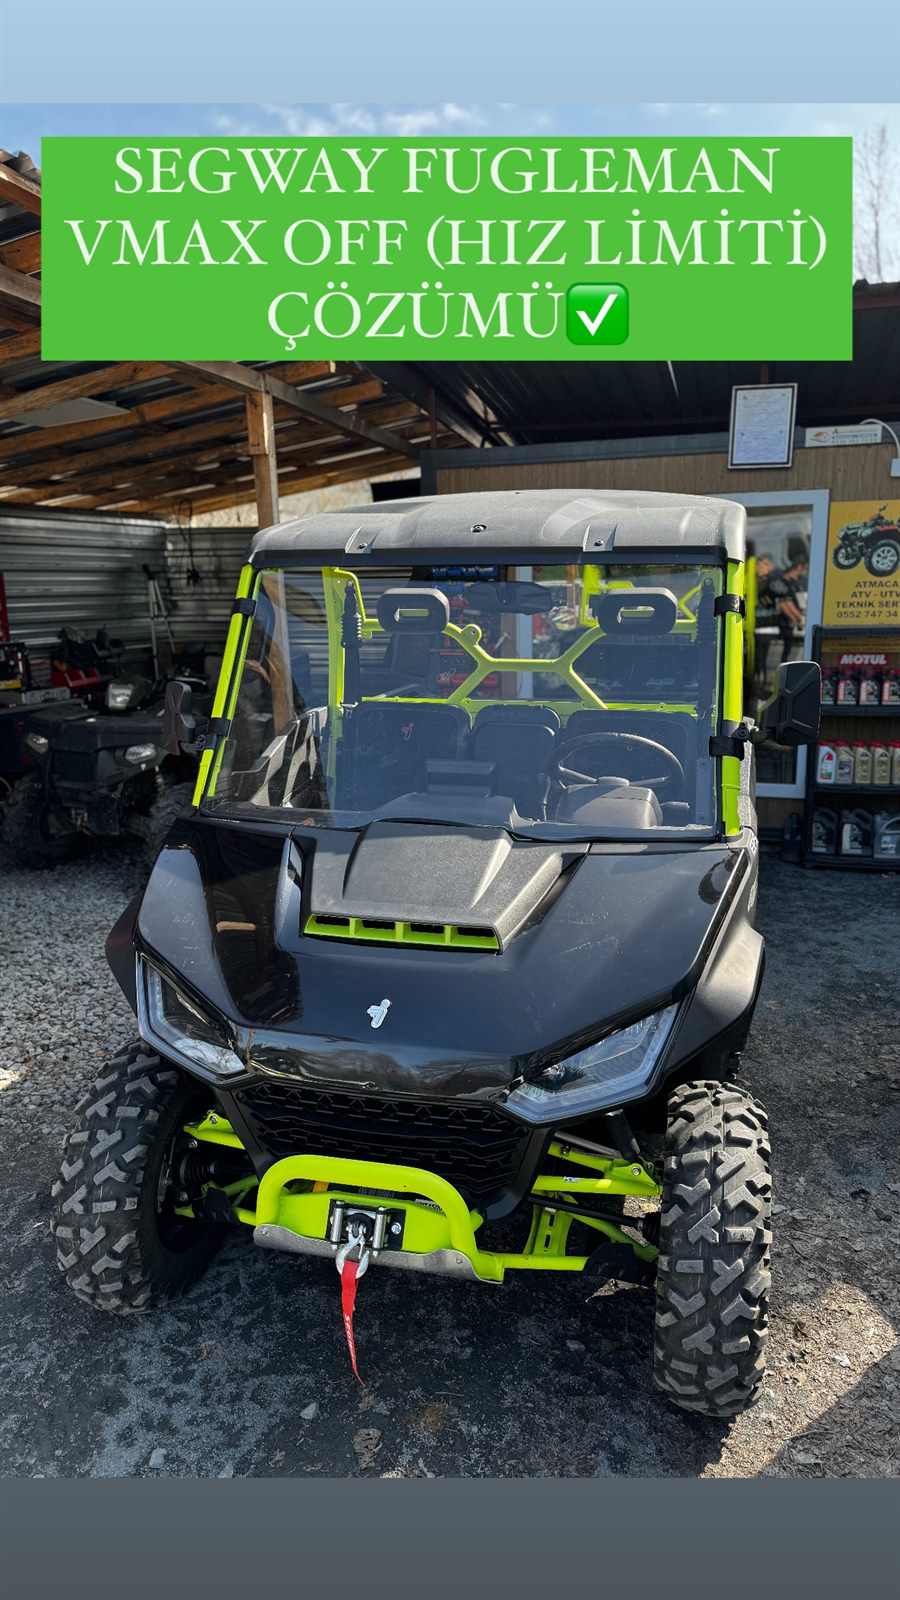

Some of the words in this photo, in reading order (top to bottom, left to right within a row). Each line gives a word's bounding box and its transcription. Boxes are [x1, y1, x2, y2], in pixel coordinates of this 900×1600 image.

[855, 580, 899, 588] ATMACA
[878, 600, 900, 608] SER
[837, 610, 861, 618] 0552
[864, 610, 882, 618] 747
[886, 610, 898, 618] 34
[840, 654, 887, 665] MOTUL
